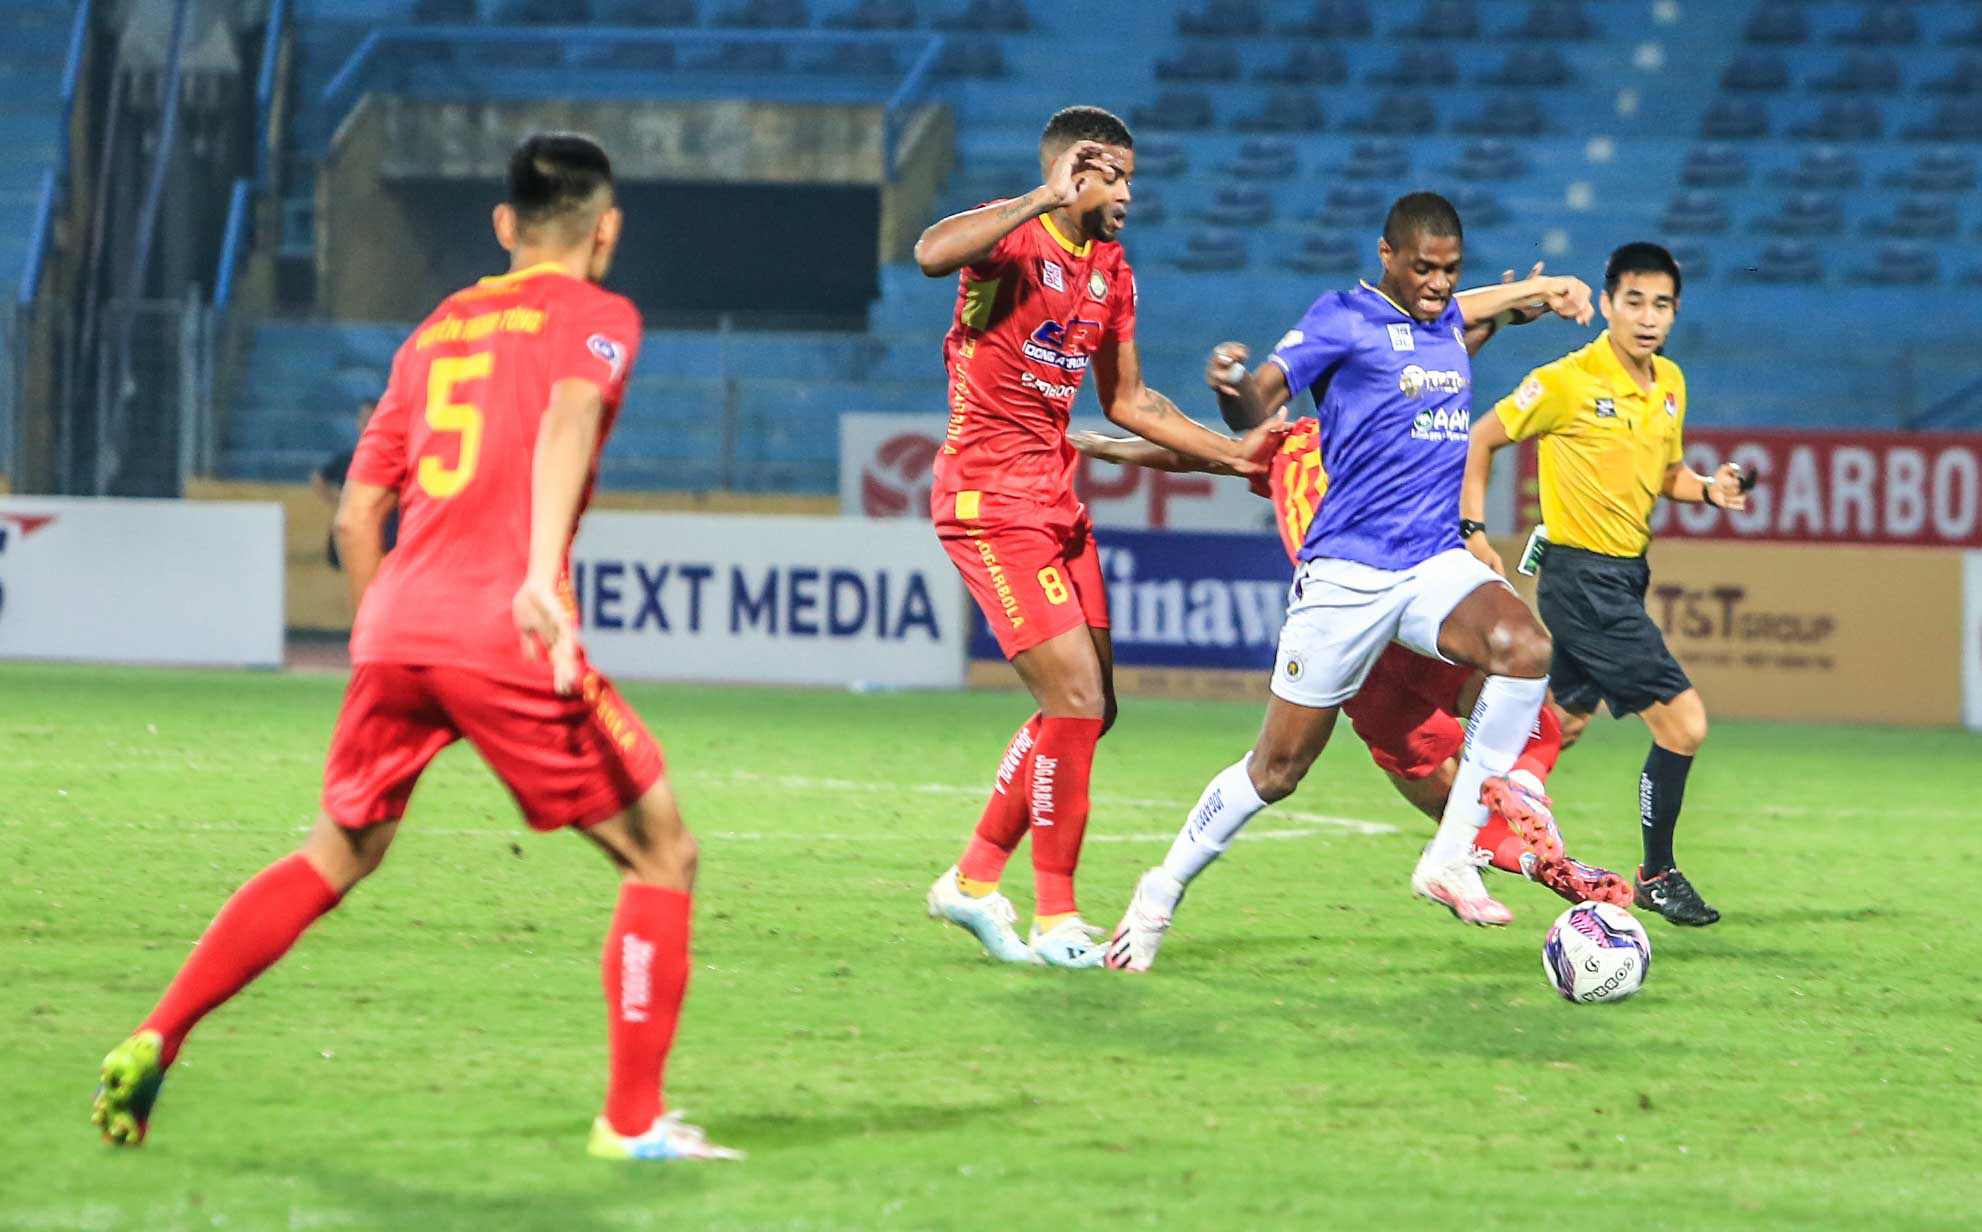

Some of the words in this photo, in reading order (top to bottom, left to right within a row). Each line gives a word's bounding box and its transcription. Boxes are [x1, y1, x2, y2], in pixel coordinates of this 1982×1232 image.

[418, 352, 494, 498] 5
[730, 565, 941, 640] MEDIA
[1037, 566, 1068, 605] 8
[994, 727, 1034, 796] JOGARBOLA
[1034, 754, 1058, 826] JOGARBOLA
[1582, 957, 1634, 1002] COBRA
